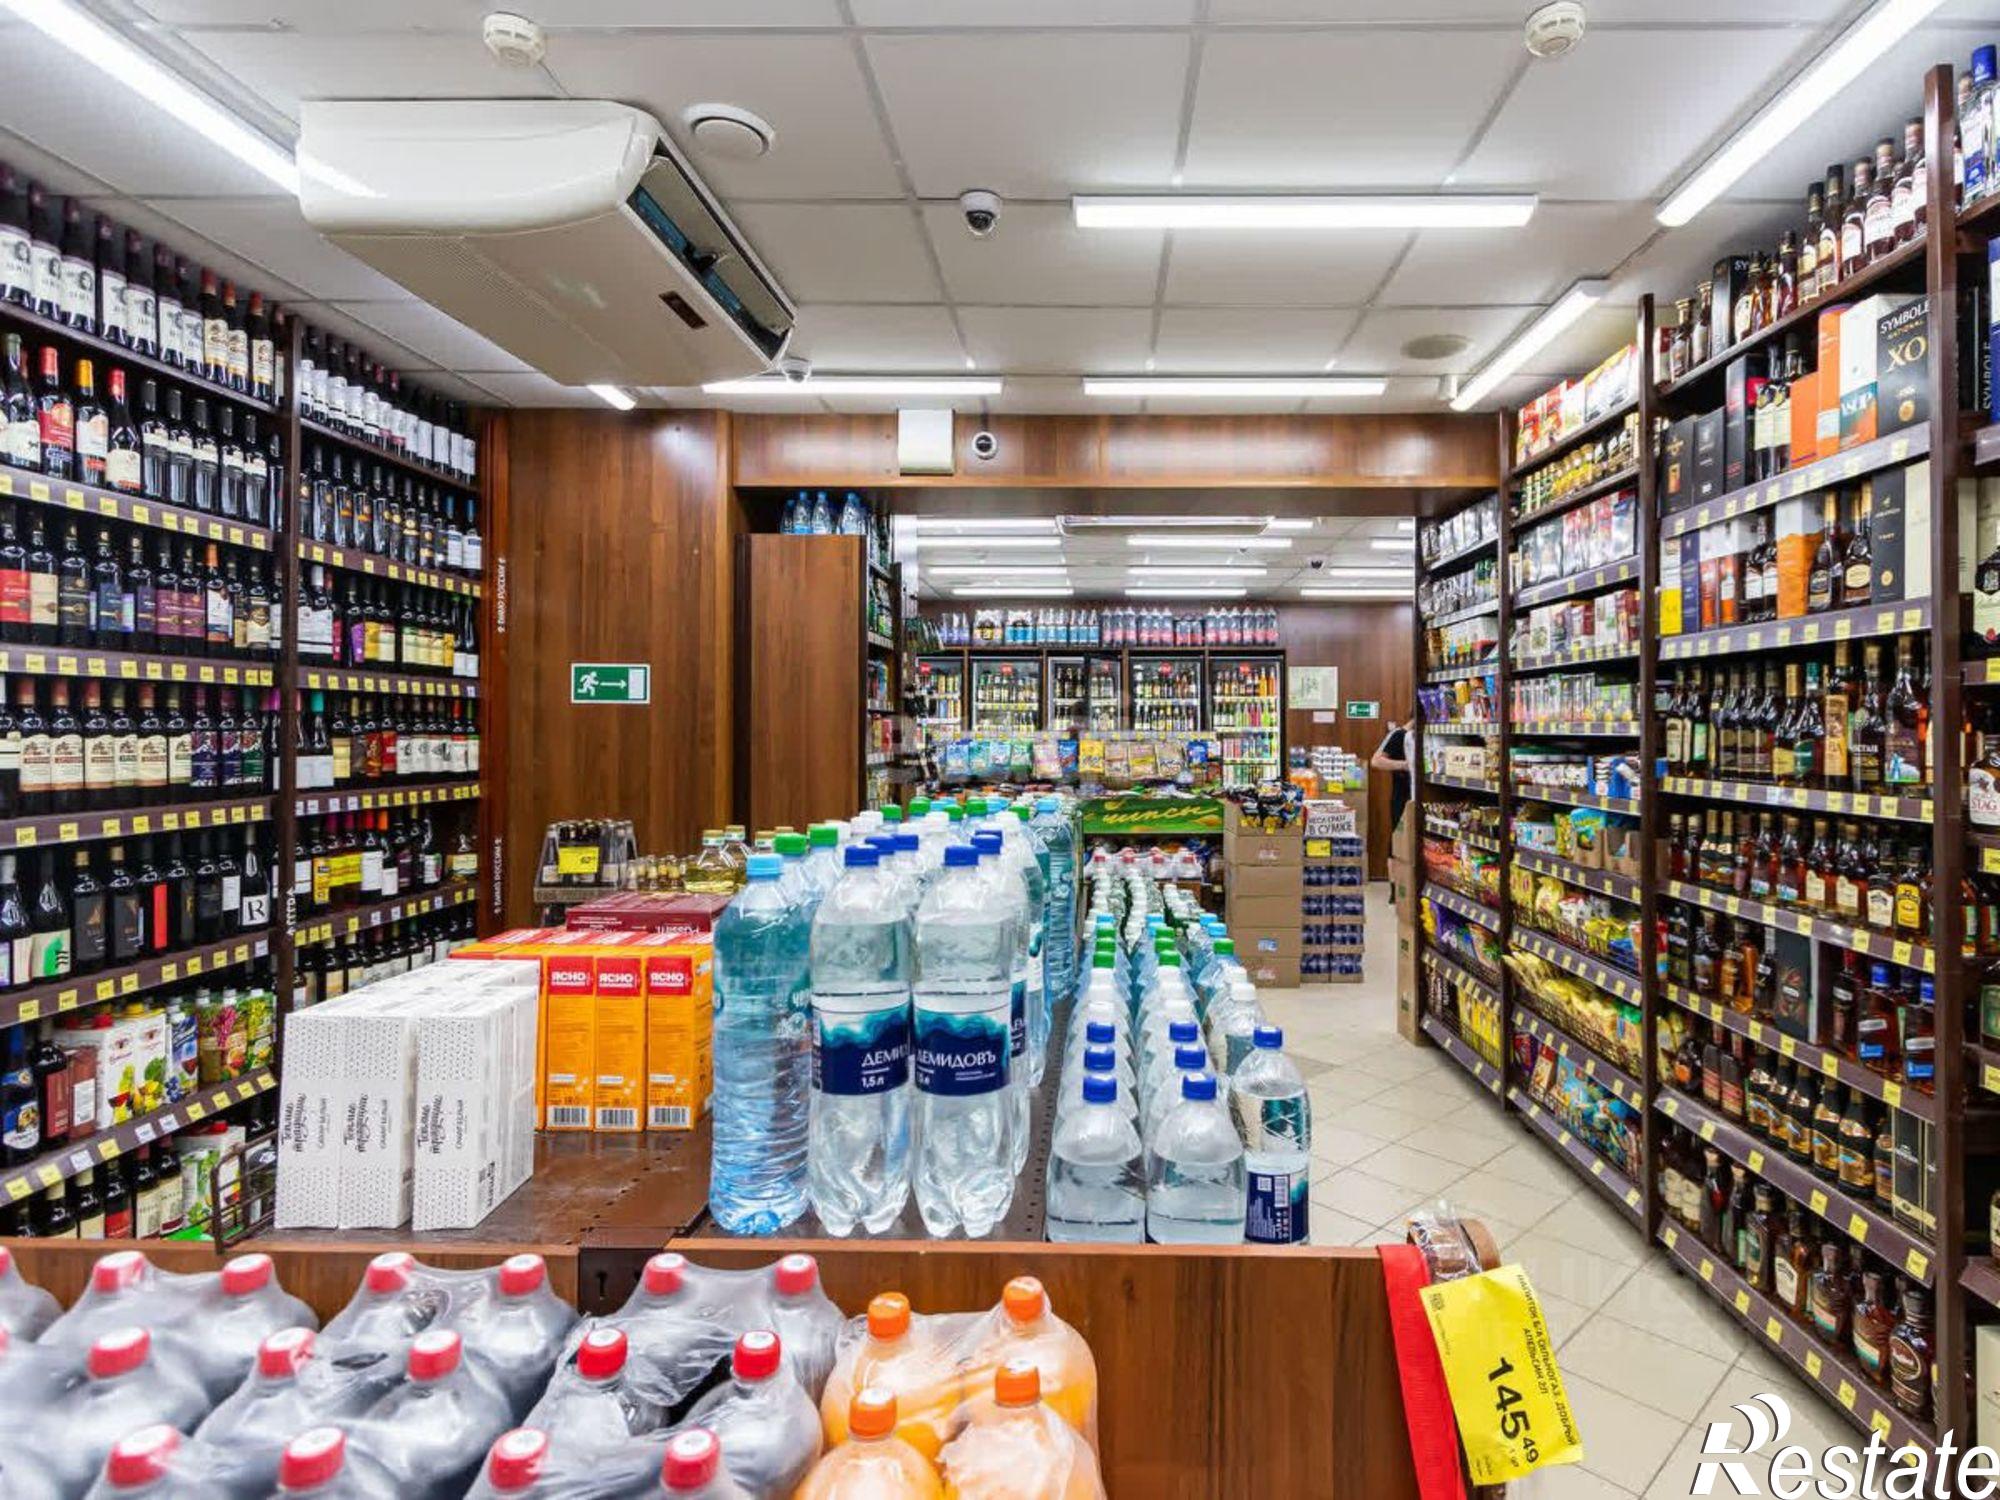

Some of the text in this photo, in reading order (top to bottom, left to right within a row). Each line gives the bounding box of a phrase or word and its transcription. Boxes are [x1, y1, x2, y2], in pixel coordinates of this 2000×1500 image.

[1880, 301, 1930, 334] SYMBOLE
[1885, 335, 1928, 373] XO
[247, 900, 266, 921] R
[1487, 1356, 1540, 1465] 145 49
